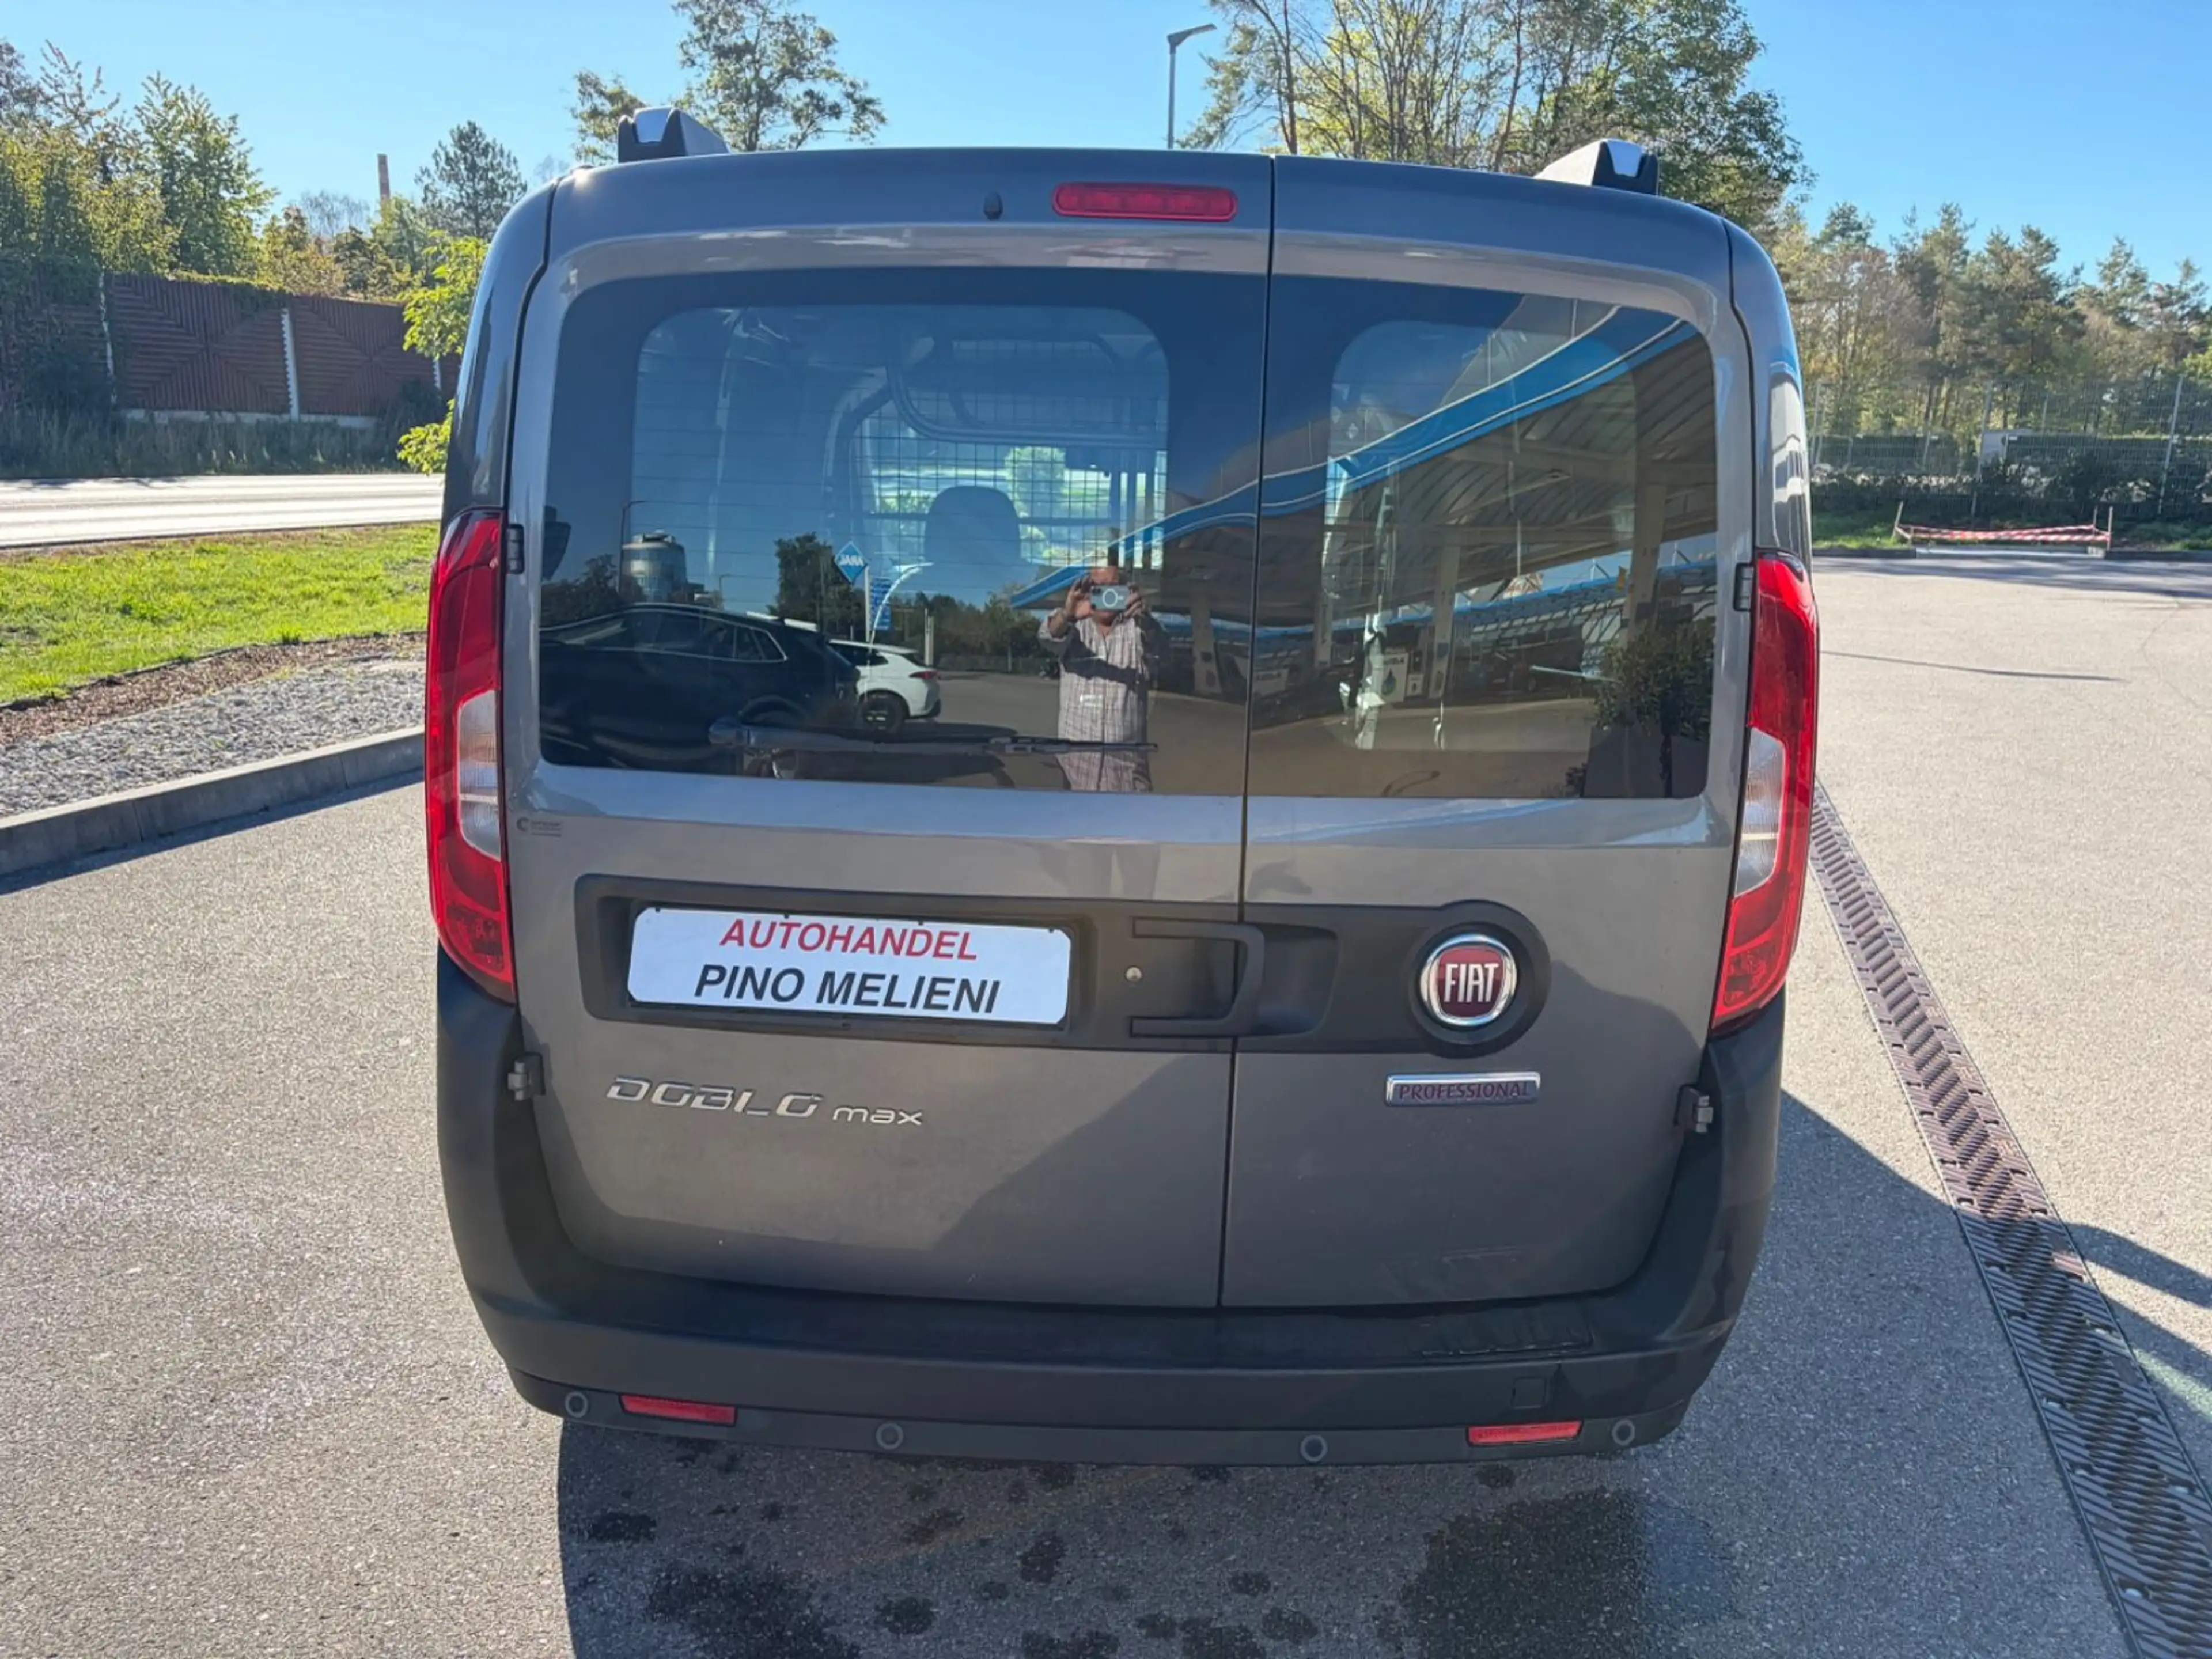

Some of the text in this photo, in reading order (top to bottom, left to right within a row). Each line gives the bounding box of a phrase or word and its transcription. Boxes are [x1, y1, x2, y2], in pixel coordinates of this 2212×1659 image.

[719, 918, 978, 960] AUTOHANDEL
[694, 964, 1001, 1014] PINO MELIENI
[1444, 963, 1499, 1003] FIAT
[1399, 1083, 1528, 1099] PROFESSIONAL
[832, 1106, 922, 1126] max
